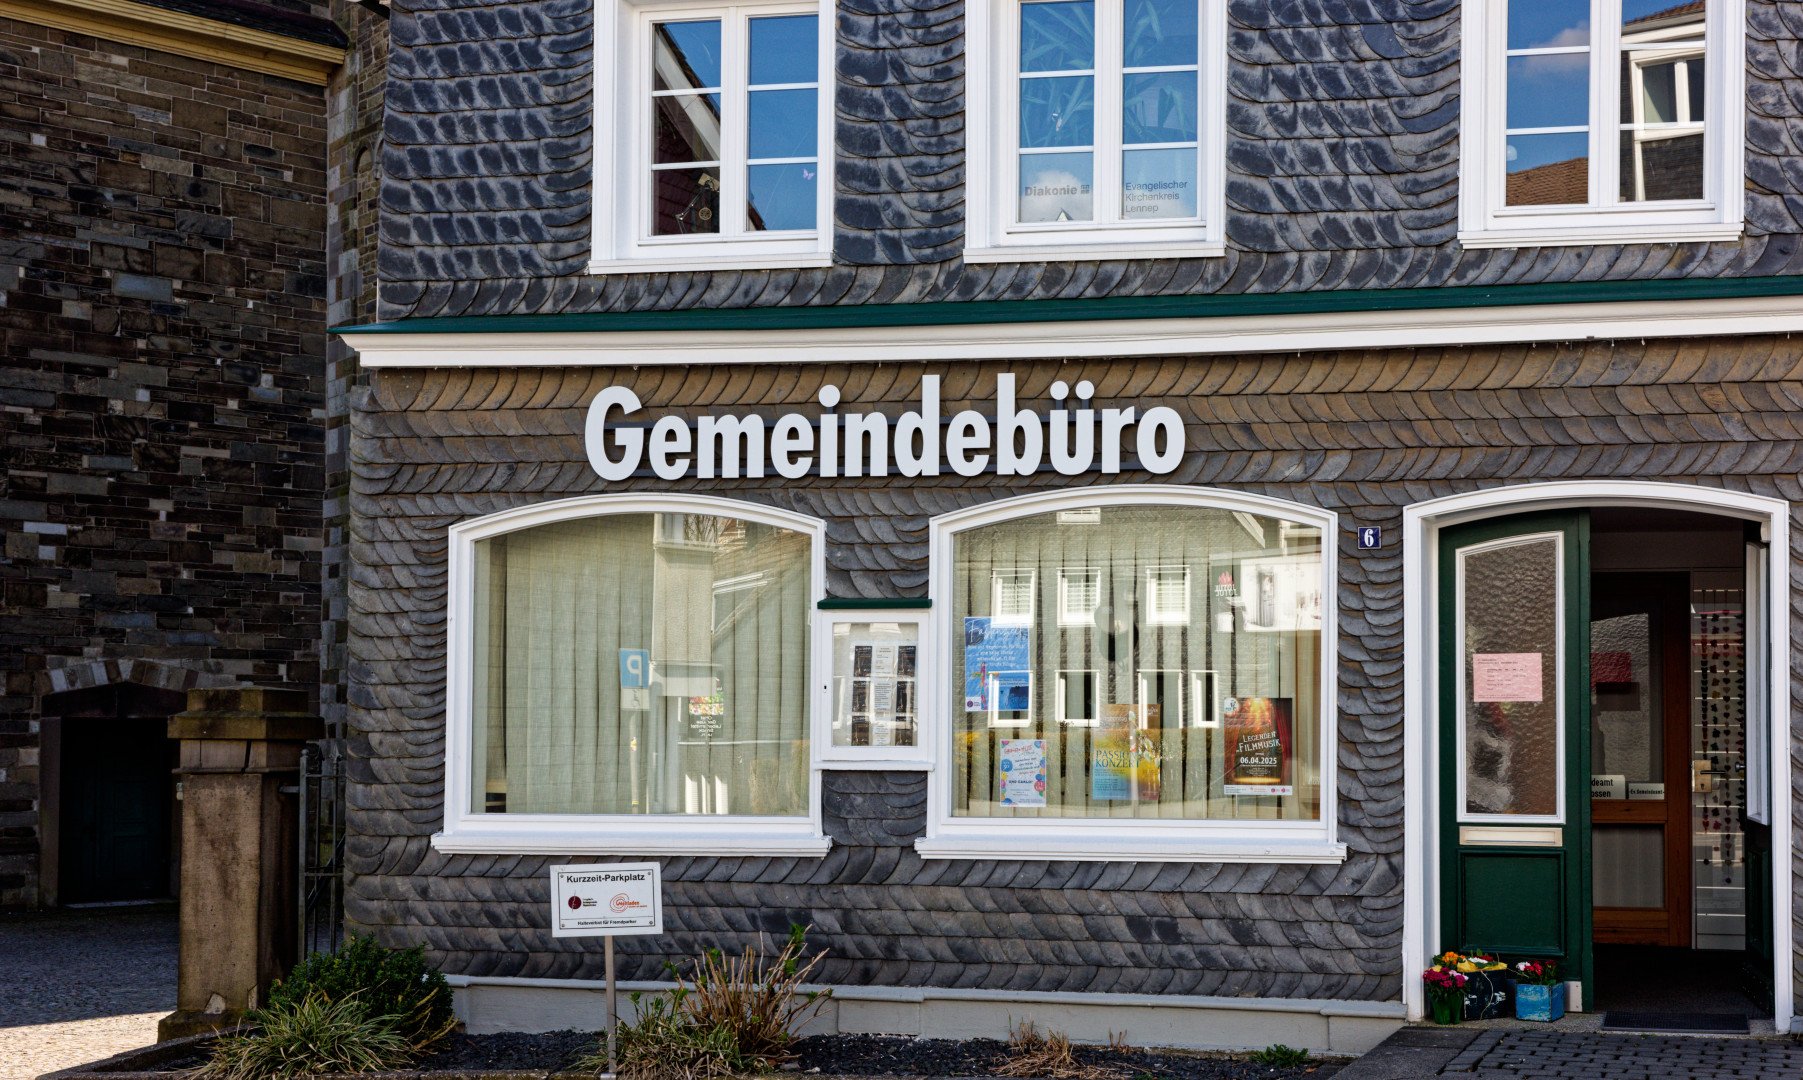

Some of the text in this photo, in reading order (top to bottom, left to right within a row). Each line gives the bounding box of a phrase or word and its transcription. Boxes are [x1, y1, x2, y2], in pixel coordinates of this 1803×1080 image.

[1024, 185, 1077, 197] Diakonie
[1125, 181, 1188, 192] Evangelischer
[1125, 192, 1180, 202] Kirchenkreis
[1125, 204, 1159, 213] Lennep
[585, 373, 1185, 481] Gemeindebüro
[1364, 528, 1374, 547] 6
[1239, 739, 1281, 752] FILMMUSIK
[1096, 750, 1142, 760] PASSIONS
[1096, 759, 1140, 768] KONZERT
[567, 874, 645, 883] Kurzzeit-Parkplatz
